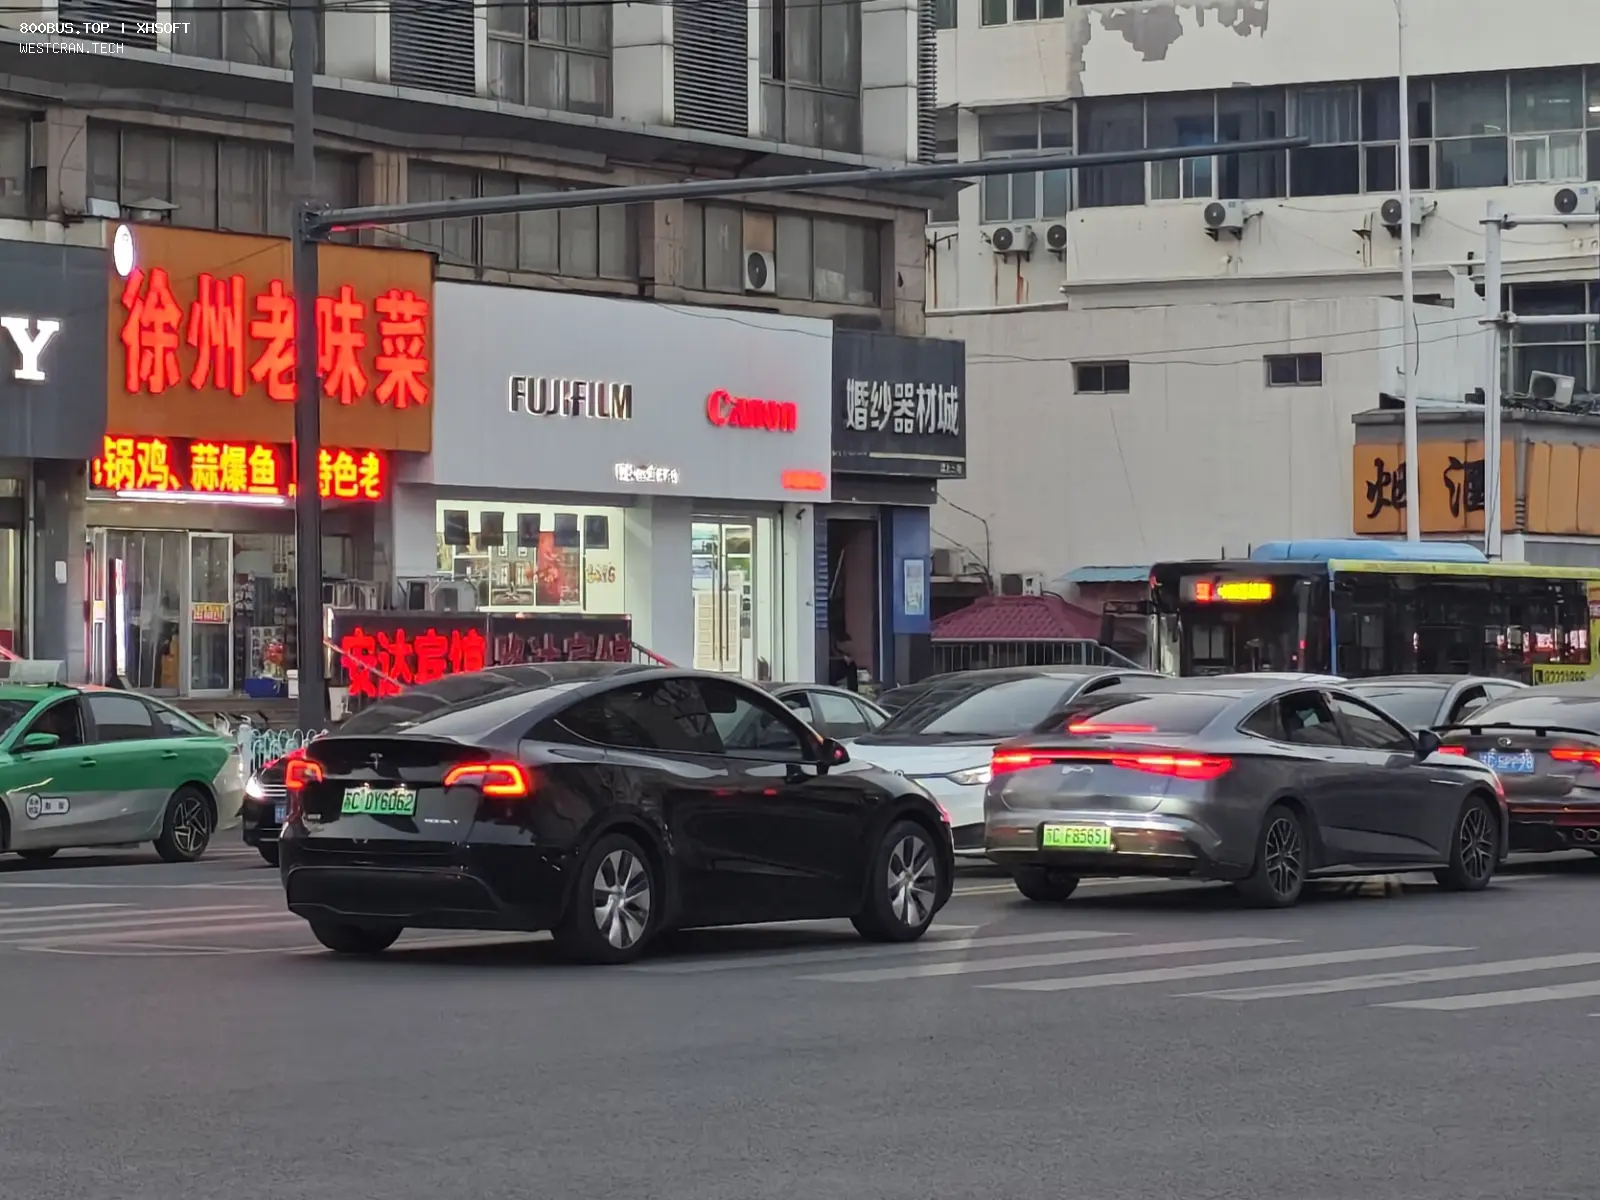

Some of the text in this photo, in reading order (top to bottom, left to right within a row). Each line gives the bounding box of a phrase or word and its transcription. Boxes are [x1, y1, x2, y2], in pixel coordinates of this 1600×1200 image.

[0, 316, 60, 381] Y
[122, 267, 429, 409] 徐州老味菜
[508, 375, 632, 420] FUJIFILM
[707, 389, 797, 432] Canon
[846, 378, 959, 436] 婚纱器材城
